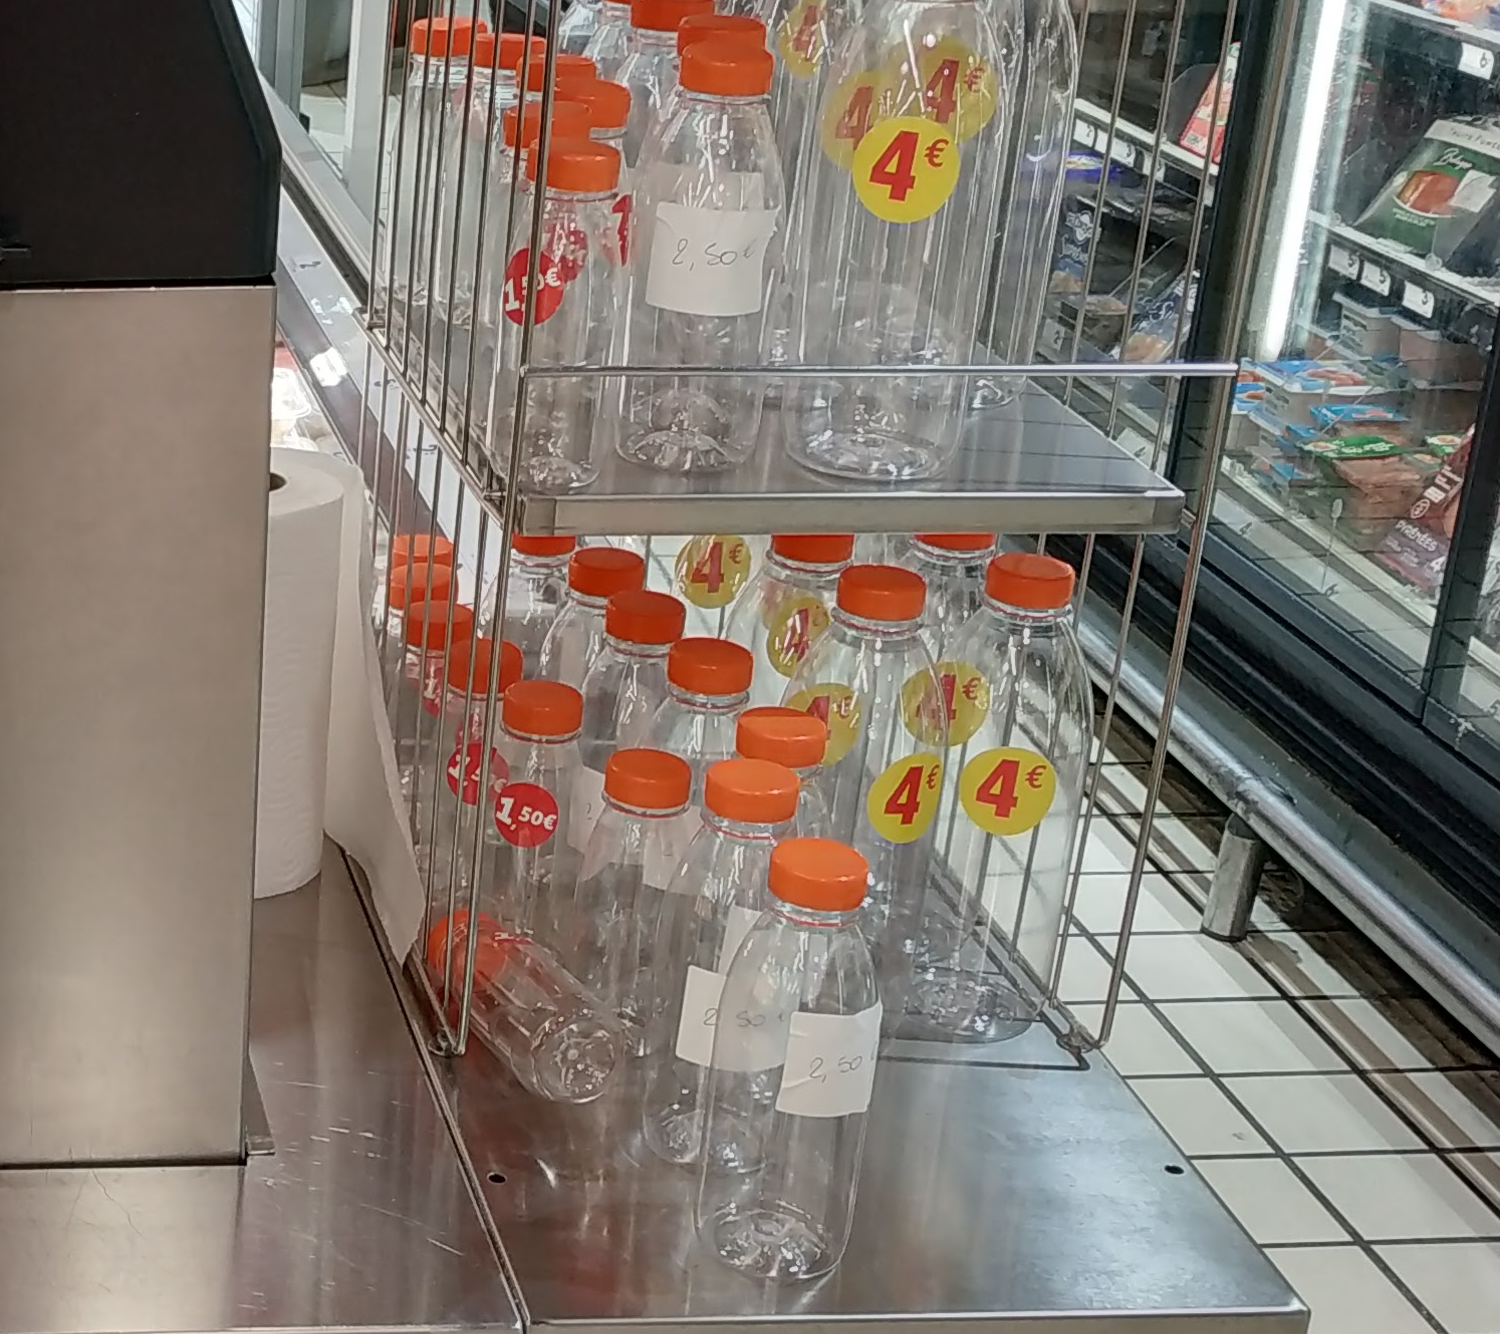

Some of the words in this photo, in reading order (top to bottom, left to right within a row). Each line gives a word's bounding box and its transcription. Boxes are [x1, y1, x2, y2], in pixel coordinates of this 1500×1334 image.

[869, 129, 949, 202] 4€
[495, 797, 558, 831] 1,50€
[884, 765, 940, 826] 4€
[976, 759, 1047, 819] 4€
